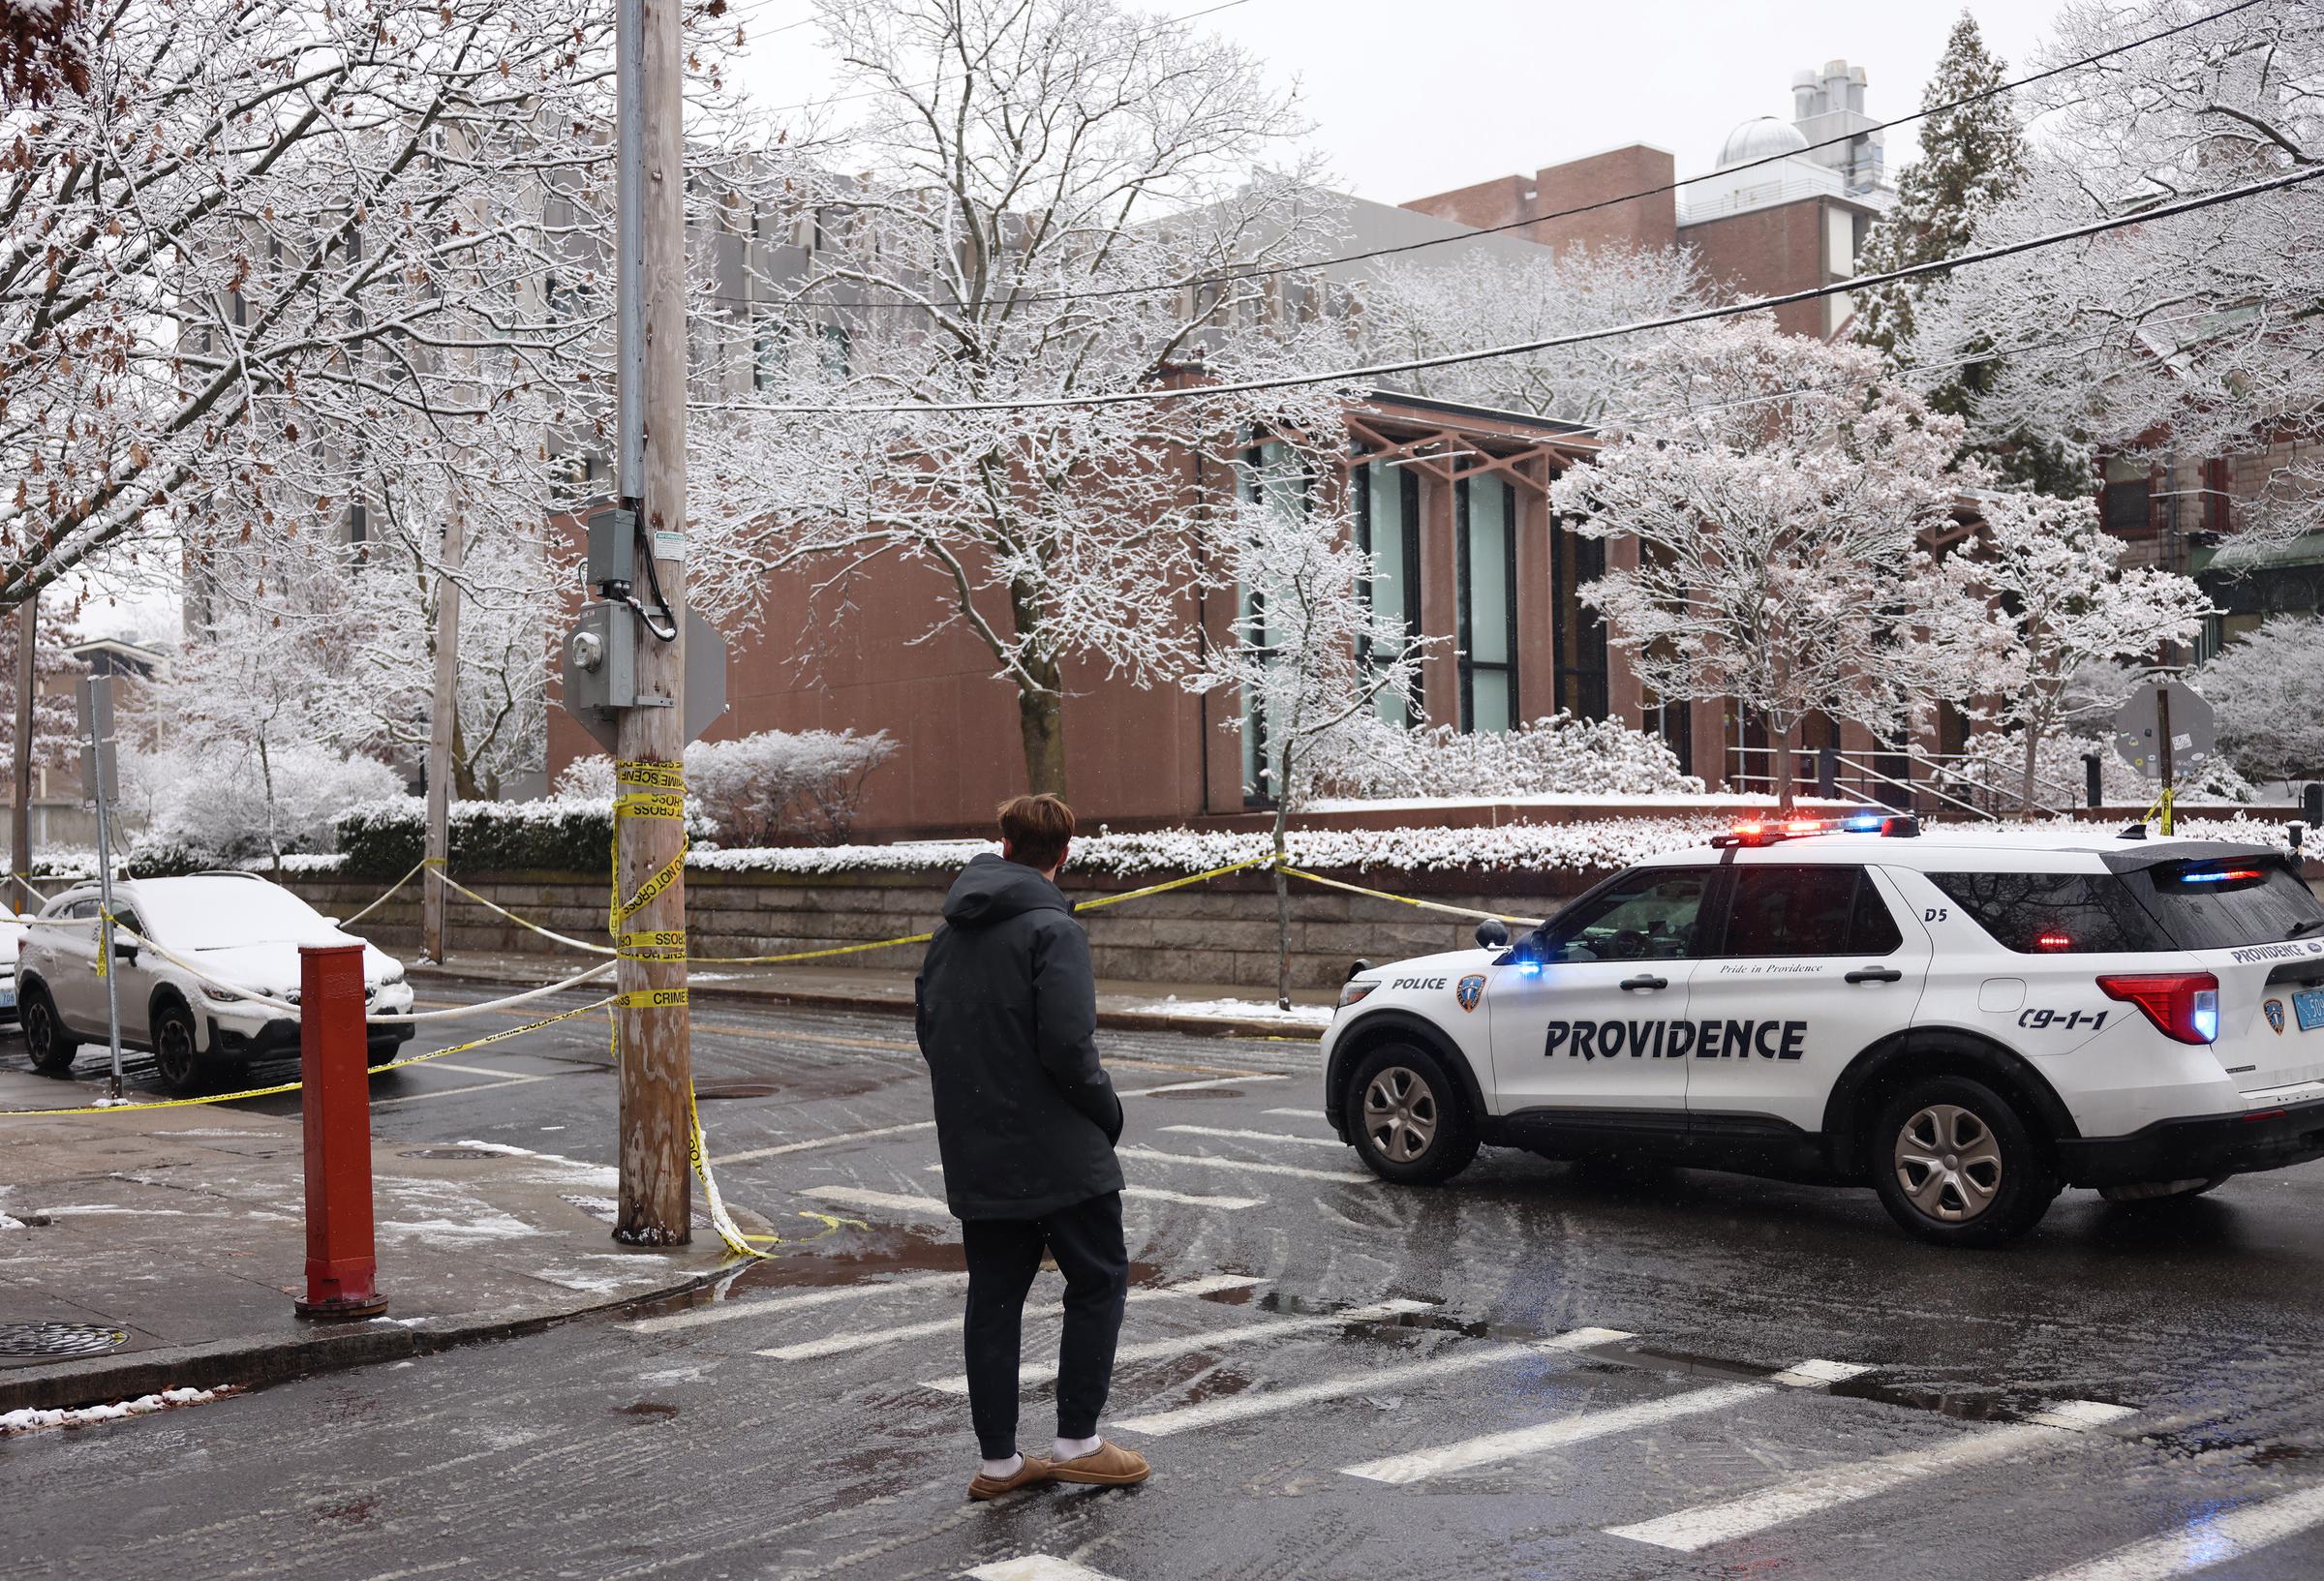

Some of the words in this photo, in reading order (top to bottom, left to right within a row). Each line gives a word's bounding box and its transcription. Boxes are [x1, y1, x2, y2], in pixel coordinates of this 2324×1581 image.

[656, 866, 677, 889] NOT
[656, 932, 685, 946] ROSS
[2231, 944, 2305, 963] PROVIDENCE
[1720, 964, 1747, 973] Pride
[1751, 964, 1762, 973] in
[1766, 963, 1822, 973] Providence
[1391, 978, 1448, 989] POLICE
[653, 991, 685, 1005] CRIME
[1544, 1019, 1808, 1062] PROVIDENCE
